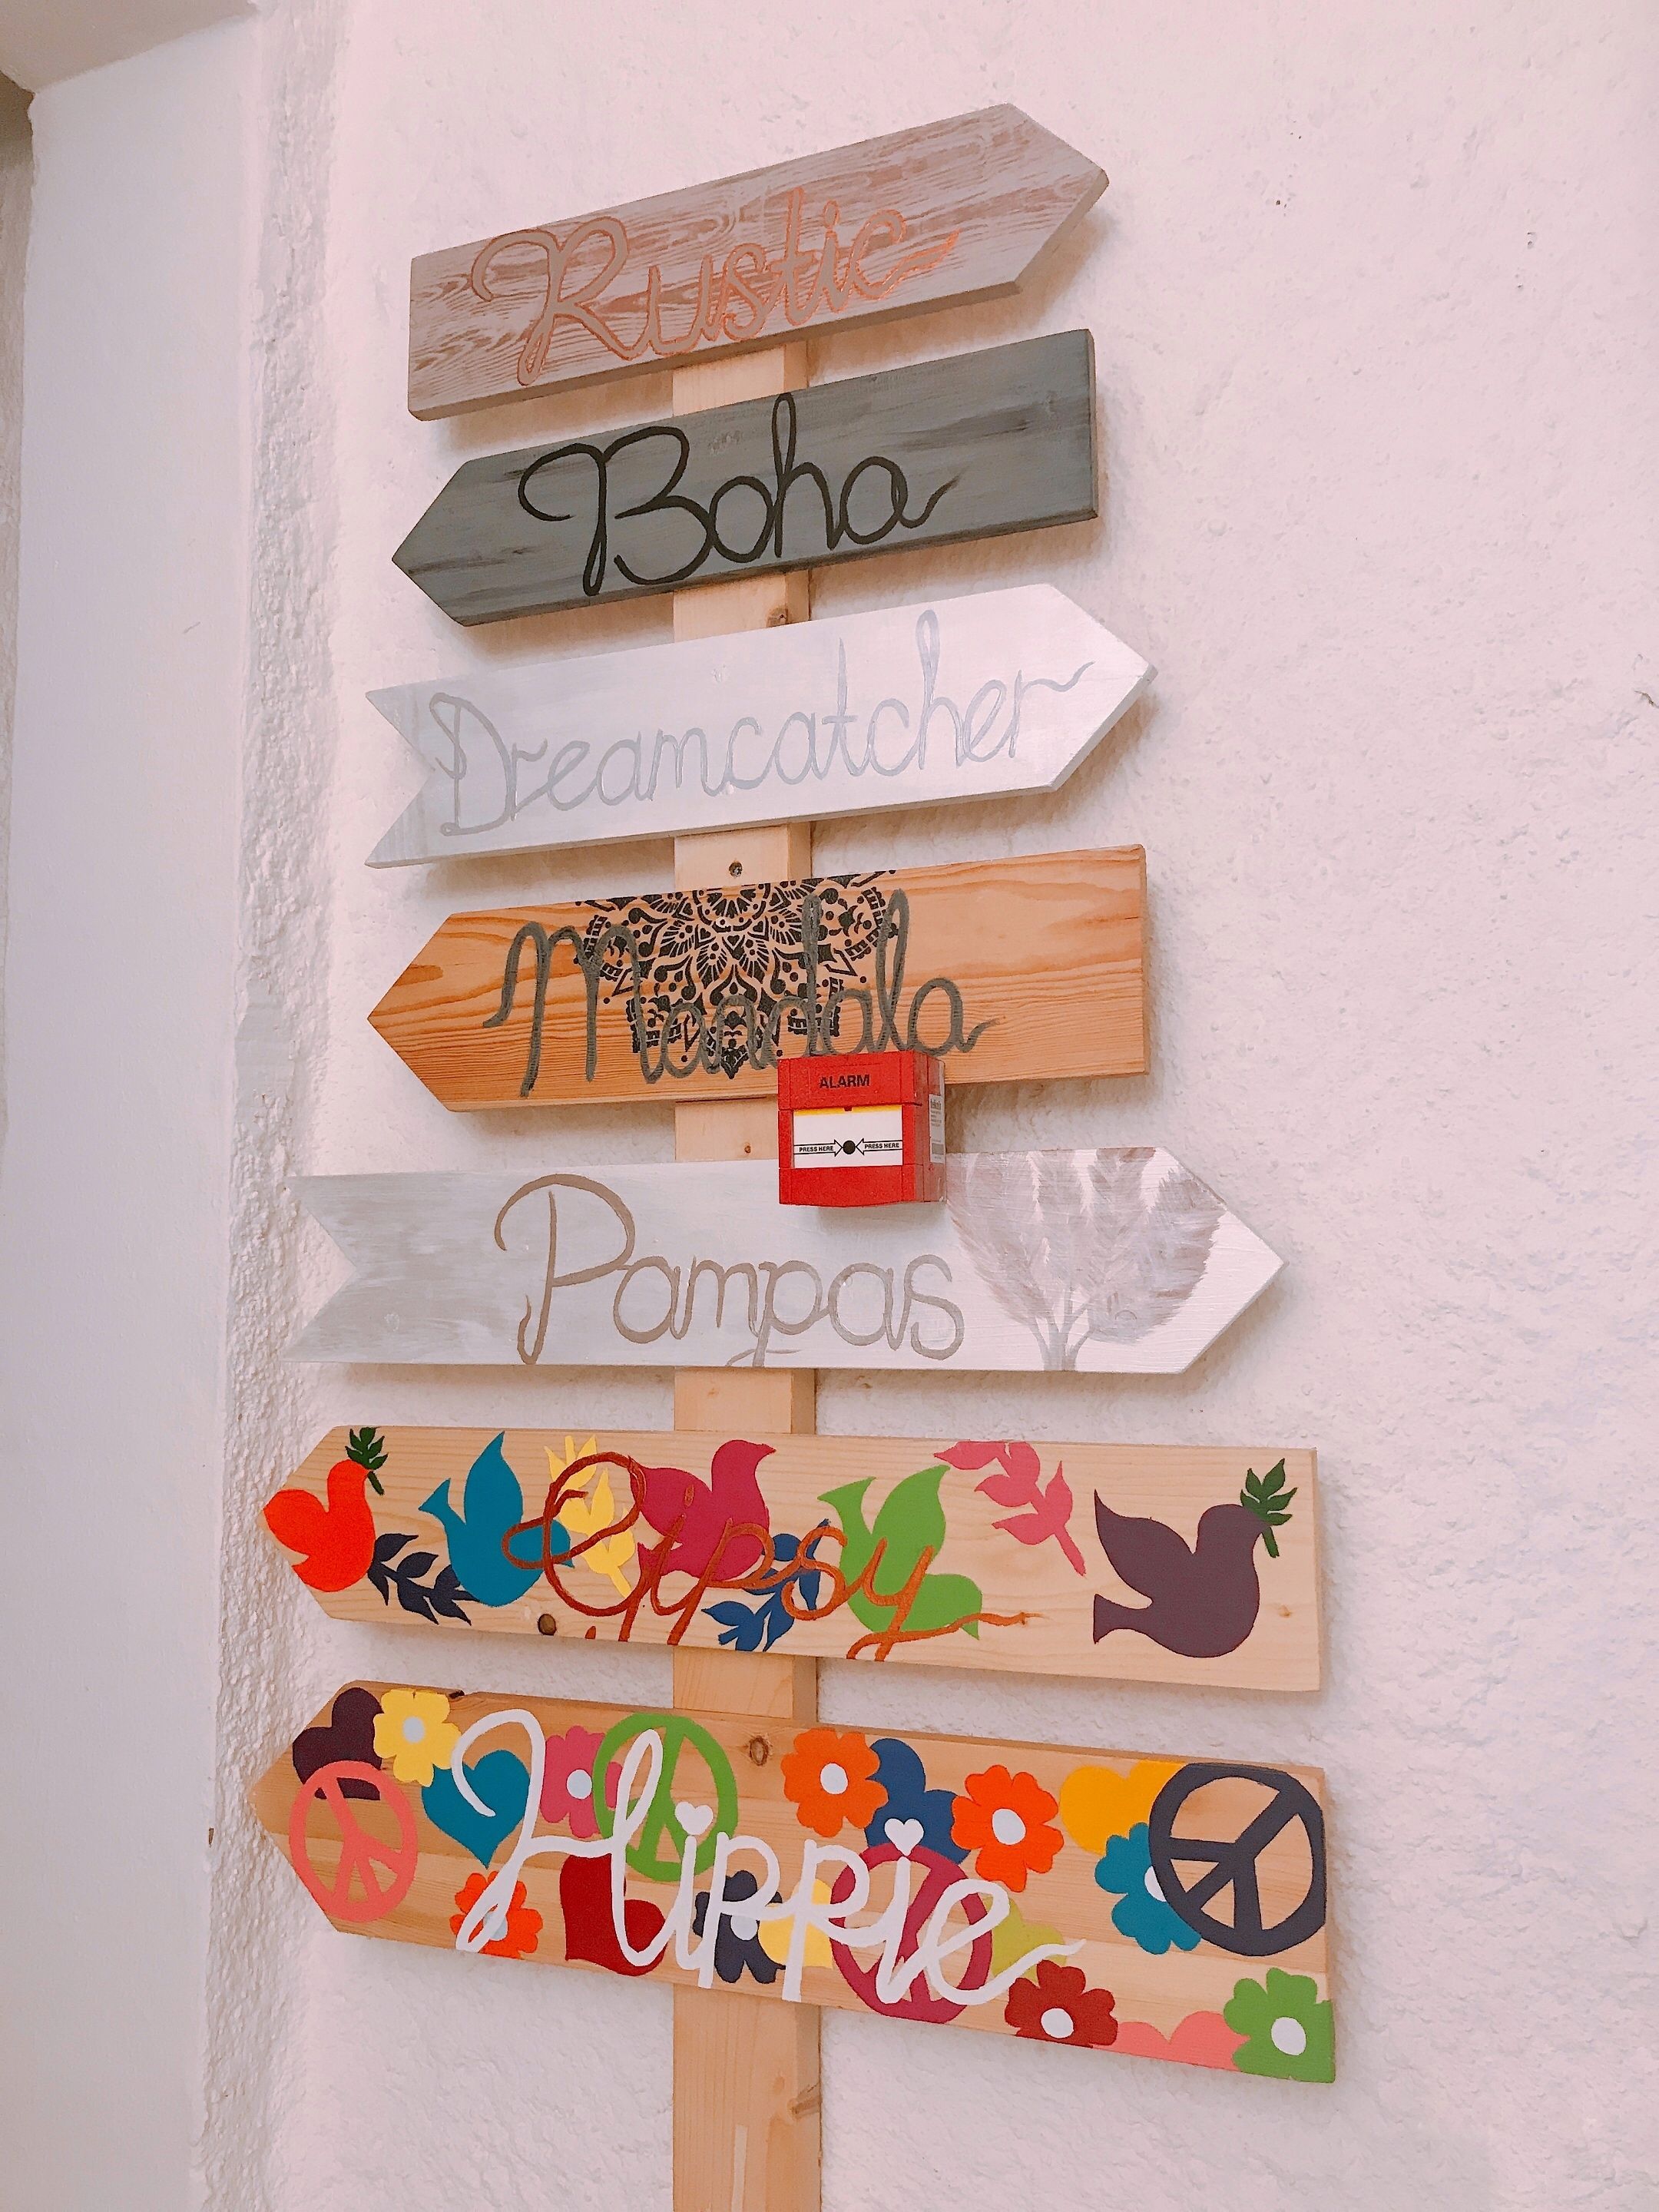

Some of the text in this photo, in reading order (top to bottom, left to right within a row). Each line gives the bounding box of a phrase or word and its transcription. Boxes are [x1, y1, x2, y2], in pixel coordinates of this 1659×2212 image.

[471, 187, 959, 386] Rustic
[428, 610, 1094, 836] Dreamcatcher
[483, 888, 997, 1098] Mandala
[820, 1075, 870, 1088] ALARM
[495, 1174, 965, 1366] Pampas
[452, 1708, 1084, 2002] Hippie
